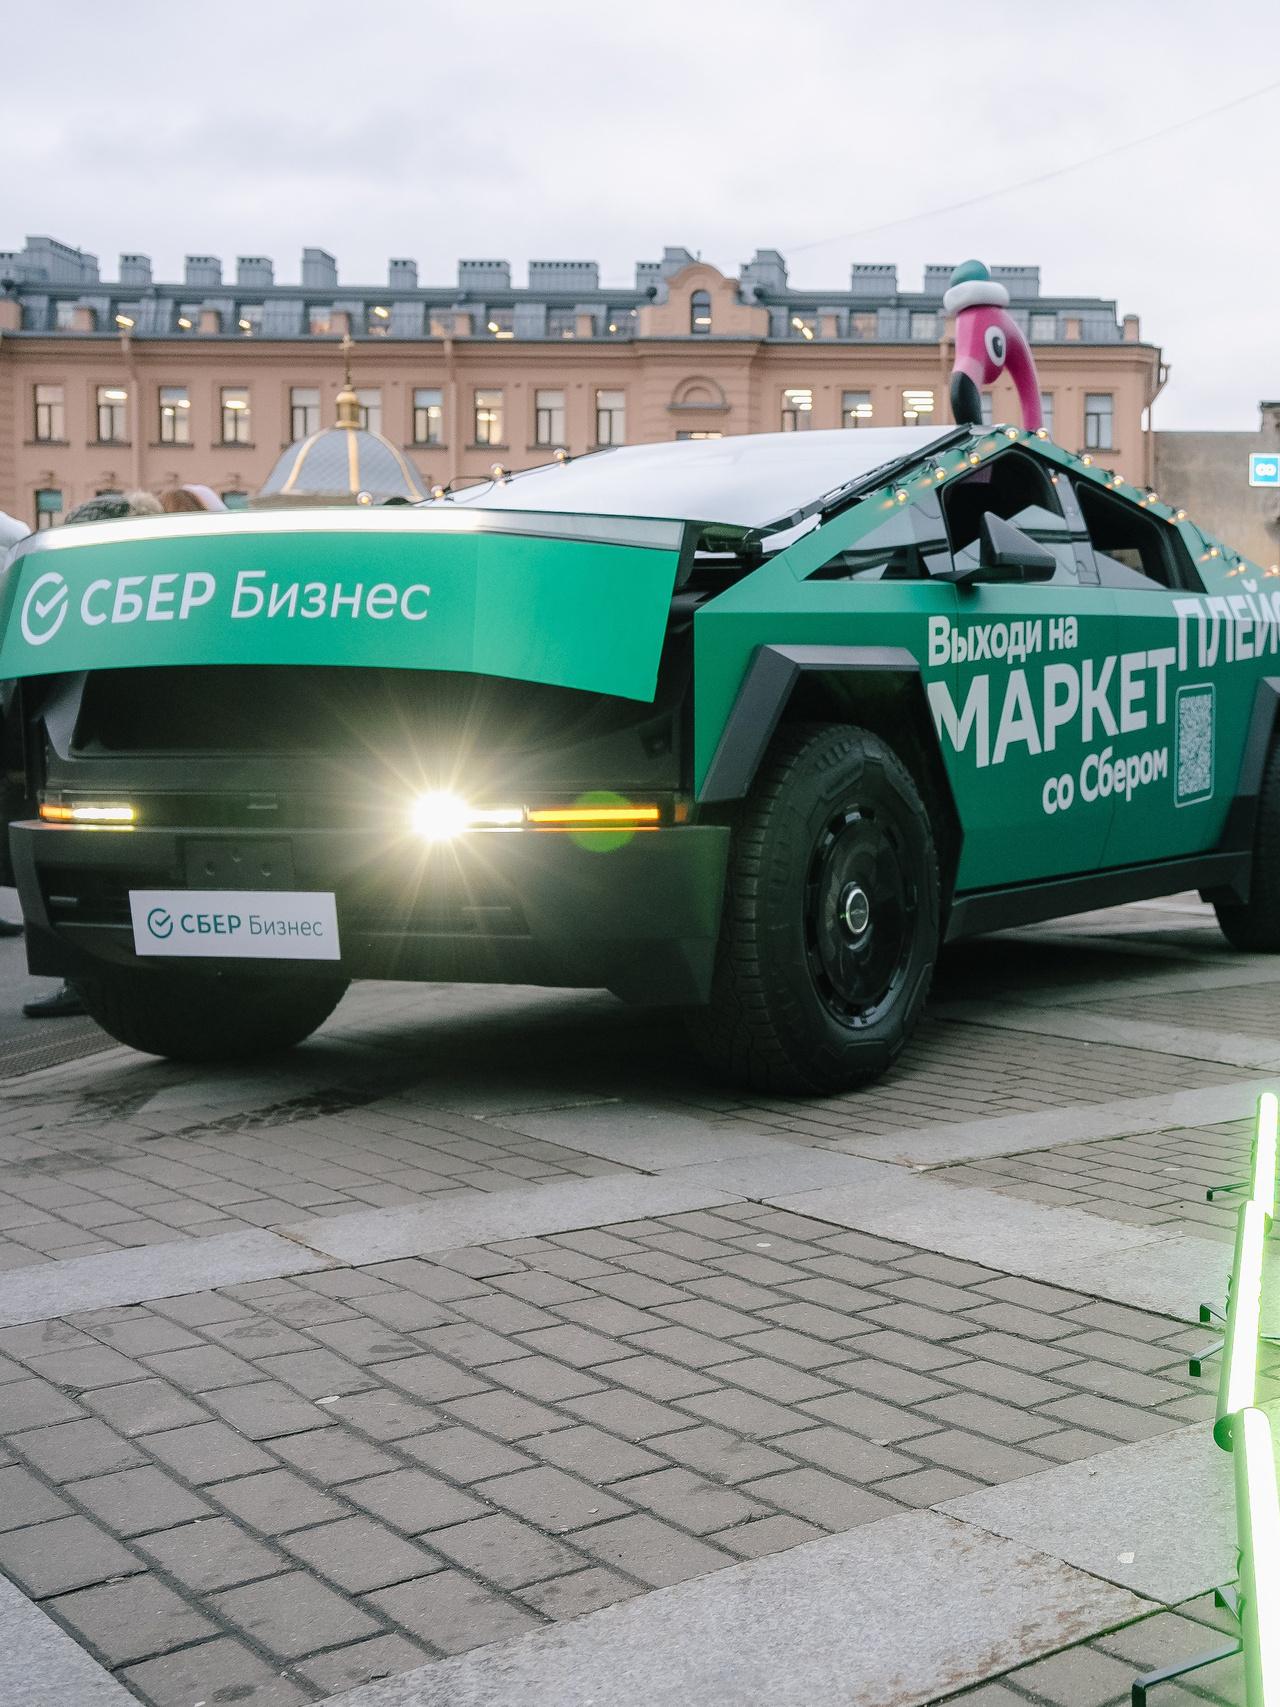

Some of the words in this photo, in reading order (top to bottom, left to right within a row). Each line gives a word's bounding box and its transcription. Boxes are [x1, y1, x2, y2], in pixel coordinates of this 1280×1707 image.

[80, 571, 217, 627] СБЕР
[230, 570, 431, 621] Бизнес
[928, 615, 1043, 667] Выходи
[1048, 615, 1079, 652] на
[927, 646, 1177, 769] МАРКЕТ
[1042, 773, 1075, 815] со
[1079, 746, 1169, 802] Сбером
[180, 914, 241, 934] СБЕР
[249, 914, 323, 937] Бизнес
